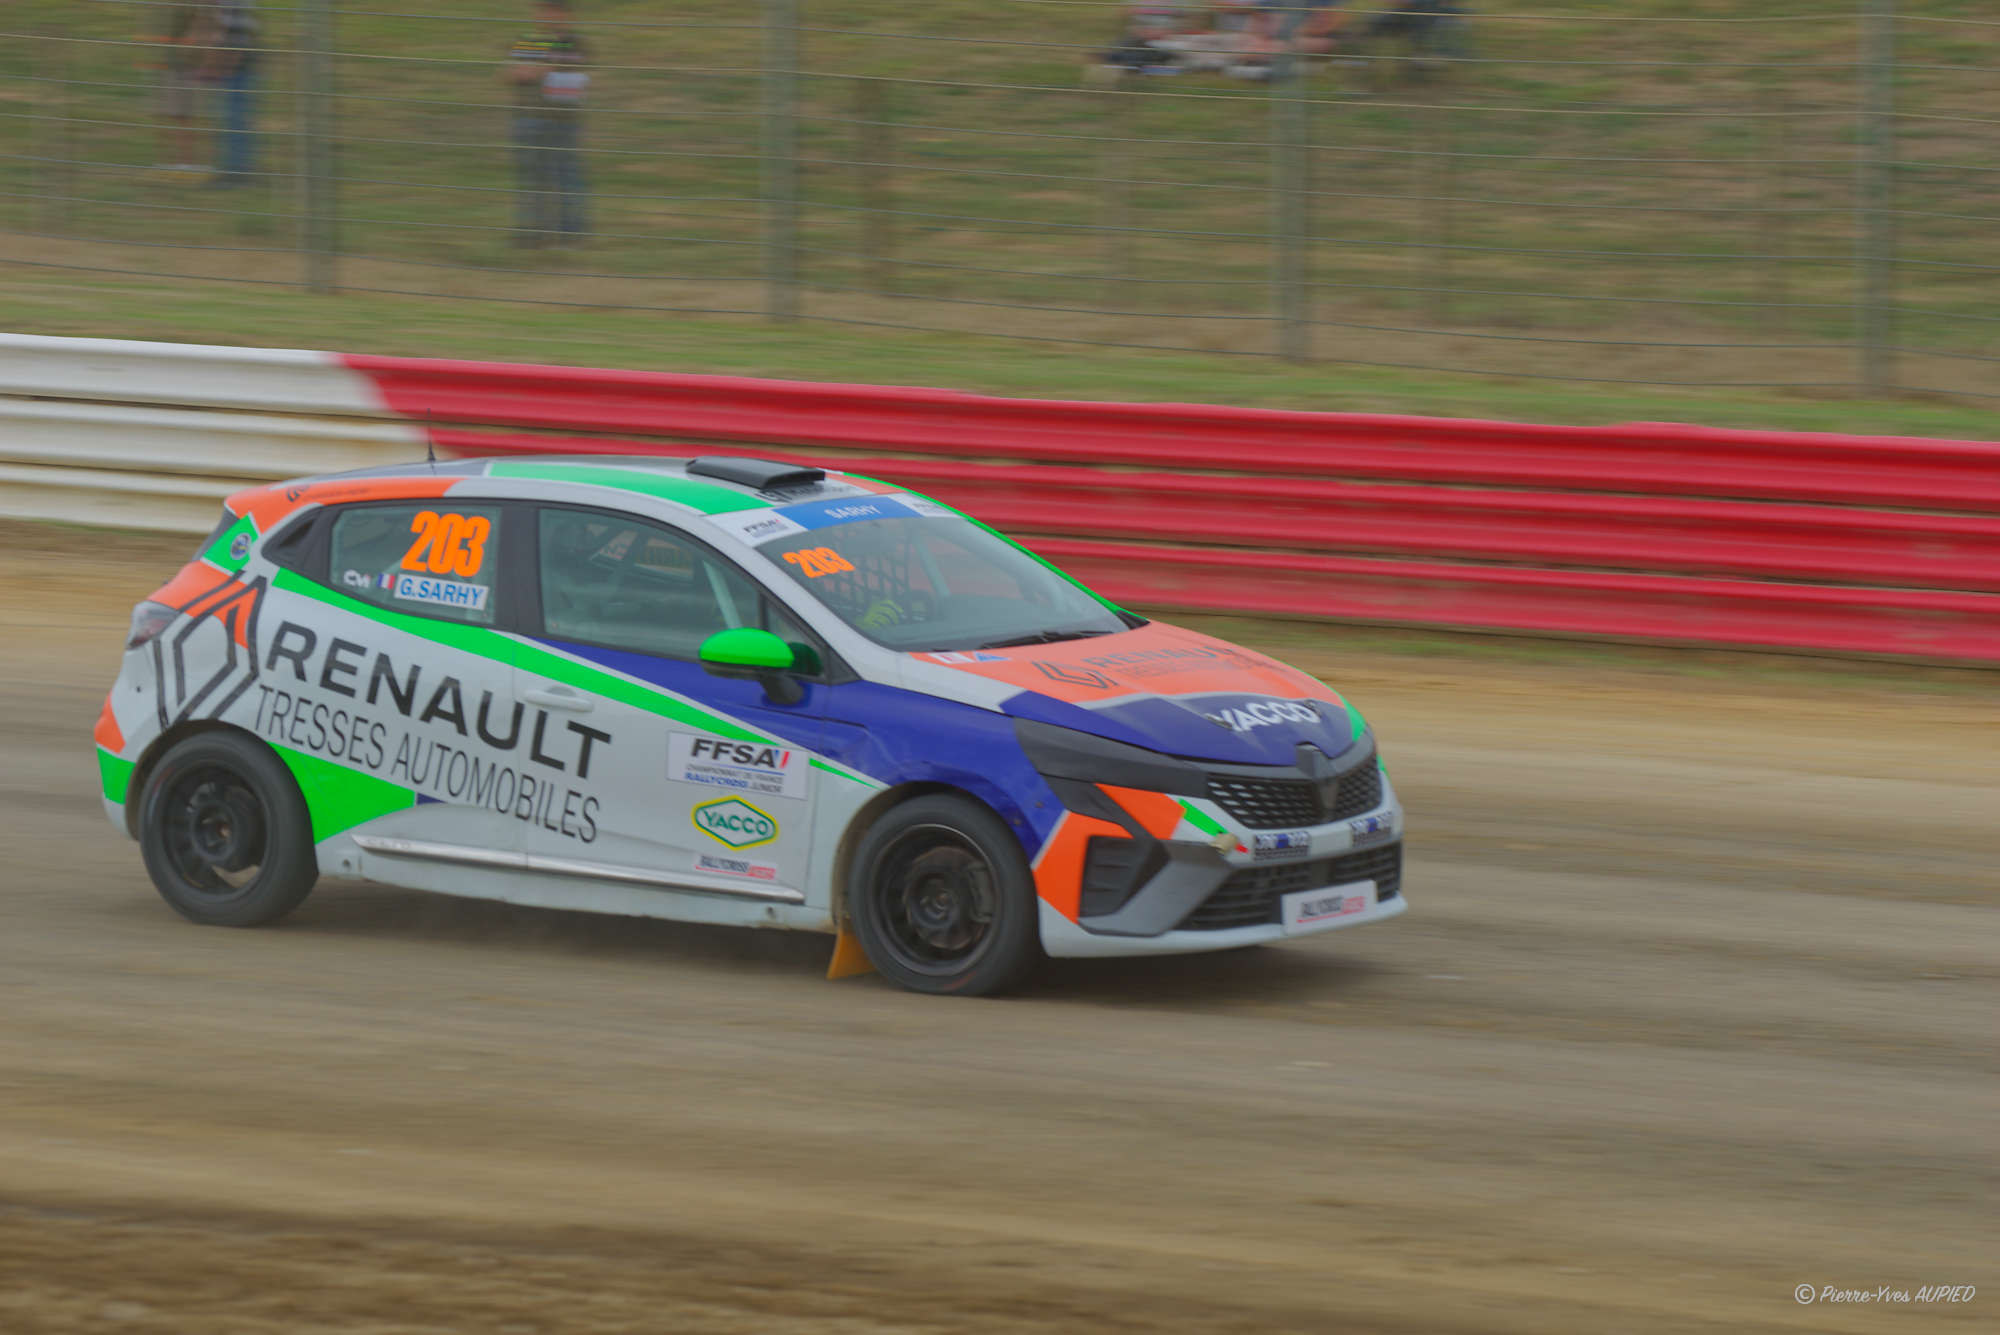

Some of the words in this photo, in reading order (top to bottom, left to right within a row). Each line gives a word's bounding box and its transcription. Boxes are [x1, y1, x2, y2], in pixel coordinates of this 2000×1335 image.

[400, 511, 491, 577] 203
[782, 547, 856, 579] 203
[400, 577, 485, 606] G.SARHY
[265, 620, 612, 780] RENAULT
[1204, 701, 1321, 732] YACCO
[254, 683, 387, 770] TRESSES
[390, 731, 601, 844] AUTOMOBILES
[690, 738, 776, 768] FFSA
[703, 808, 769, 836] YACCO
